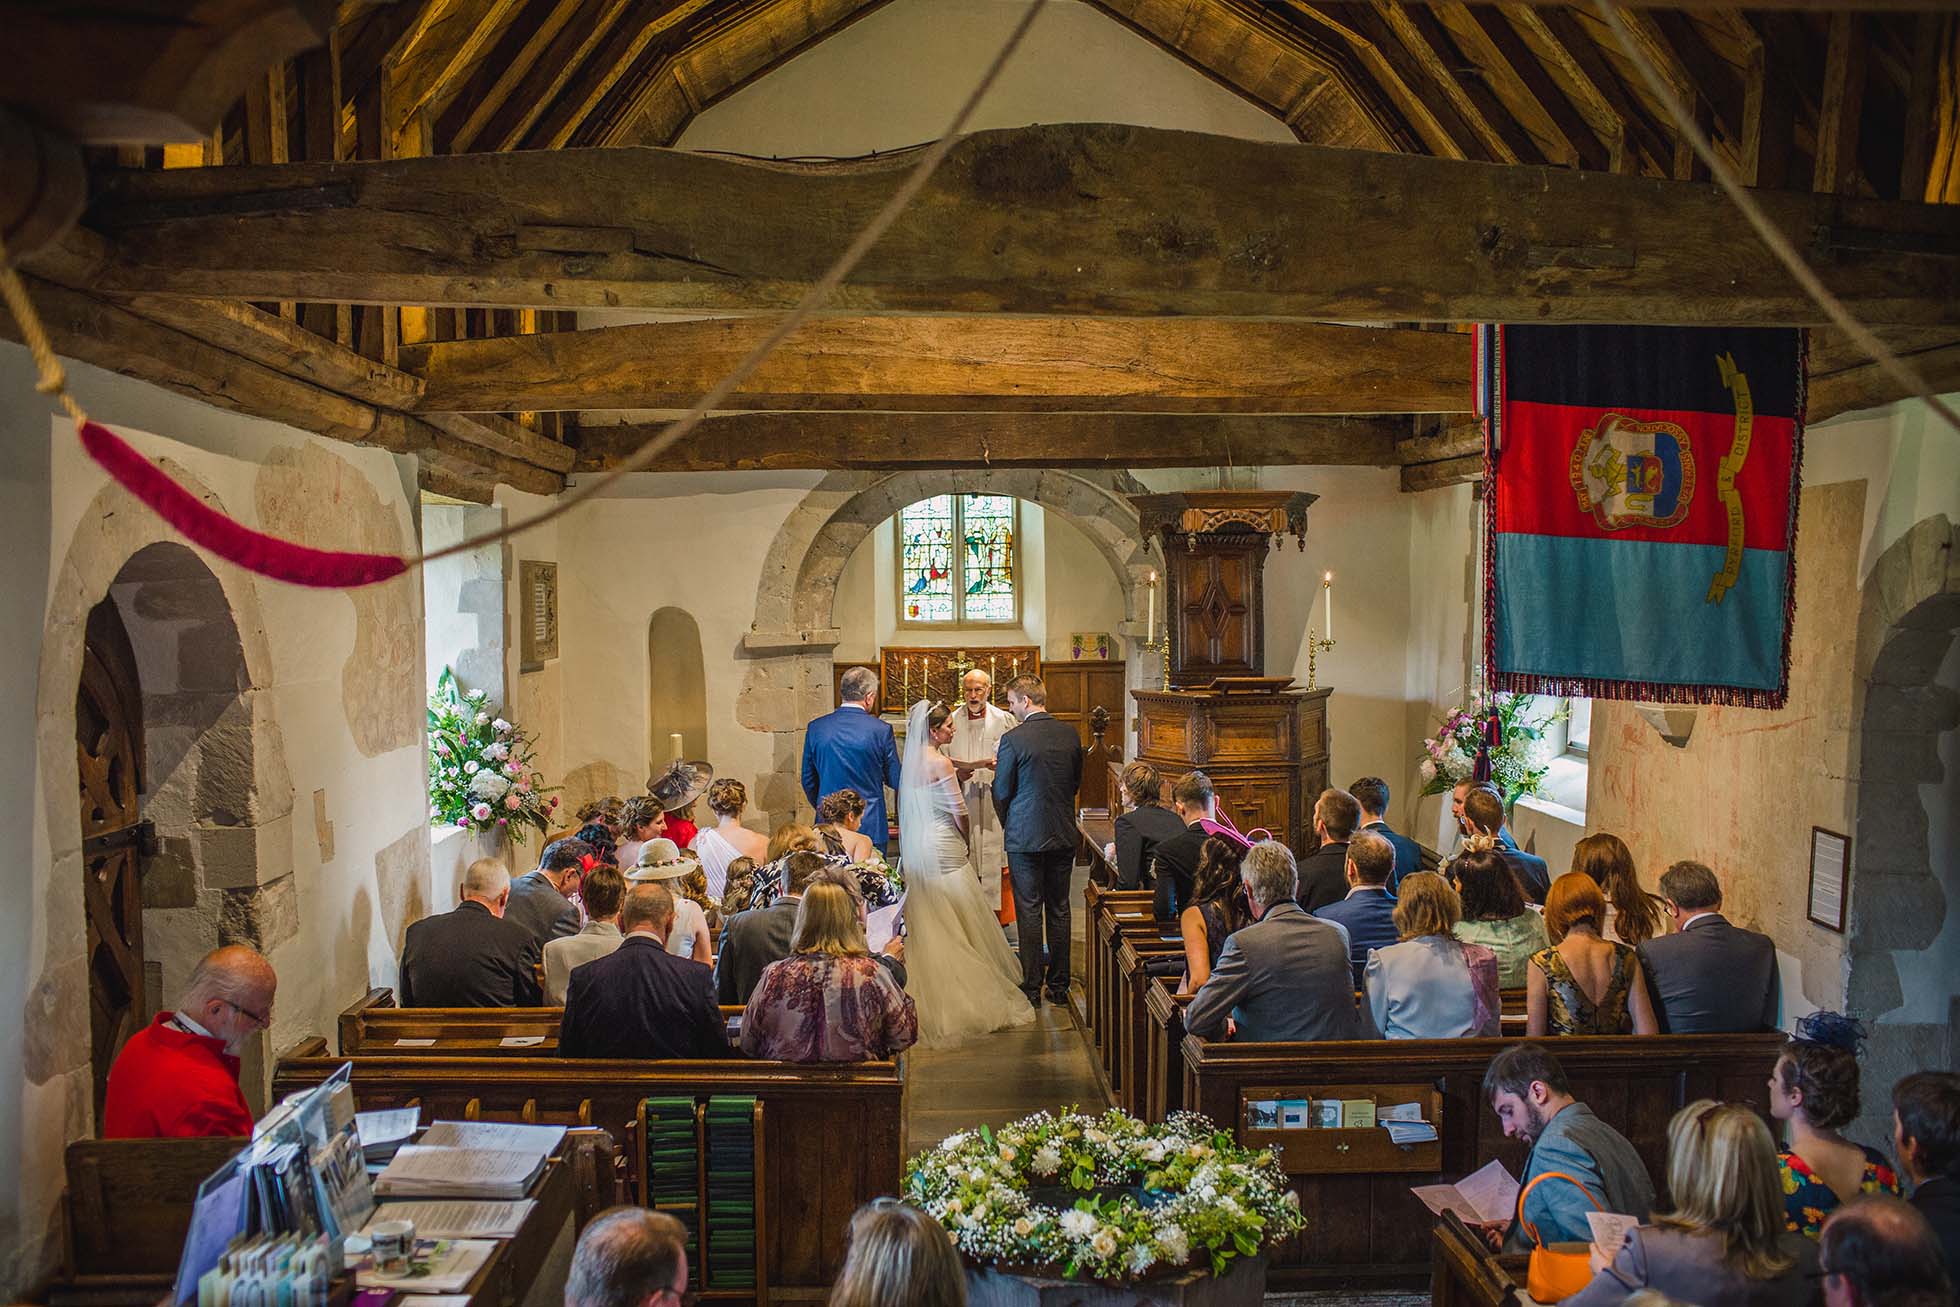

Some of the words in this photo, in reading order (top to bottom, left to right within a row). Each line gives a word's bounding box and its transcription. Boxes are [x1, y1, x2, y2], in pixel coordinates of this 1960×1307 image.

[1637, 423, 1688, 445] ASSOCIATION
[1734, 392, 1750, 456] DISTRICT
[1571, 454, 1583, 485] 1940
